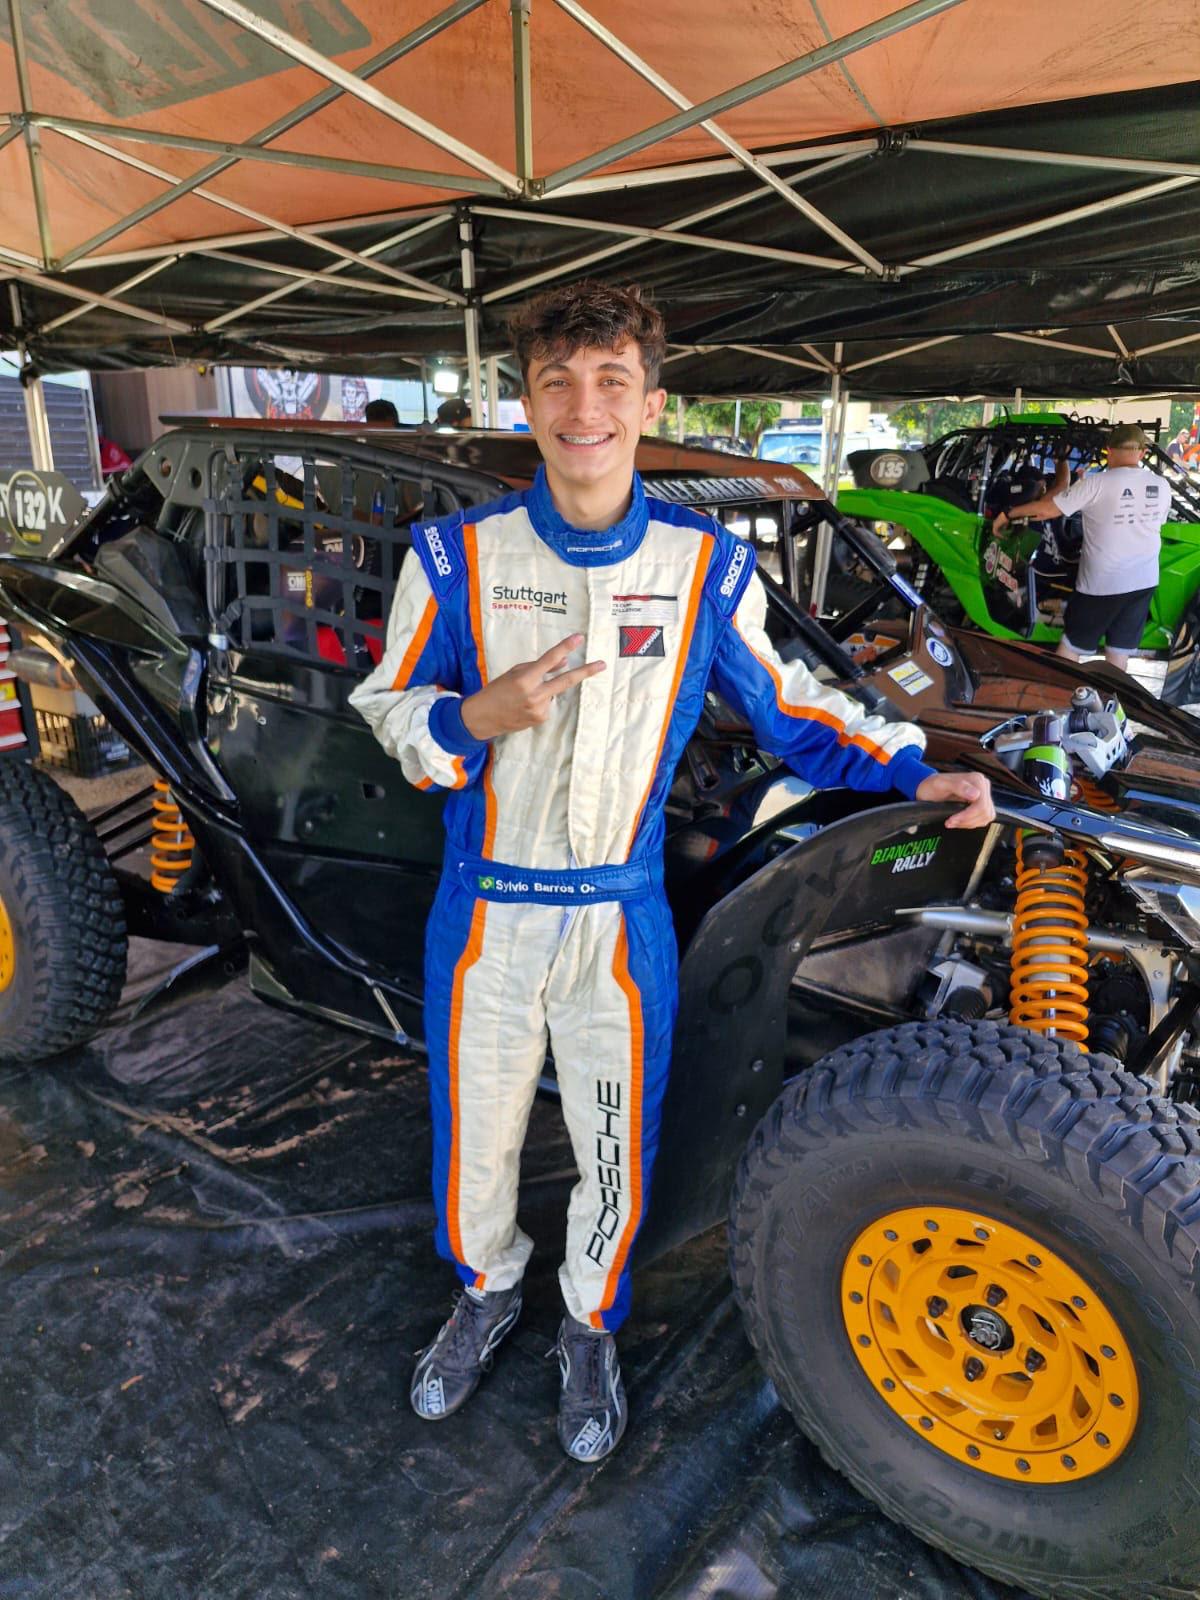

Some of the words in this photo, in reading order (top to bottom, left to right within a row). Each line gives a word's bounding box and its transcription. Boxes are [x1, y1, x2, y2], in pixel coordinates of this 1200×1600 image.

[877, 461, 905, 479] 135
[14, 489, 47, 530] 132
[425, 526, 452, 576] sparco
[566, 539, 624, 553] PORSCHE
[719, 544, 747, 597] sparco
[492, 585, 568, 607] Stuttgart
[870, 835, 943, 865] BIANCHINI
[891, 850, 936, 875] RALLY
[495, 879, 529, 894] Sylvio
[534, 882, 575, 894] Barros
[584, 1079, 621, 1267] PORSCHE
[426, 1377, 444, 1414] OMP
[573, 1419, 603, 1456] OMP
